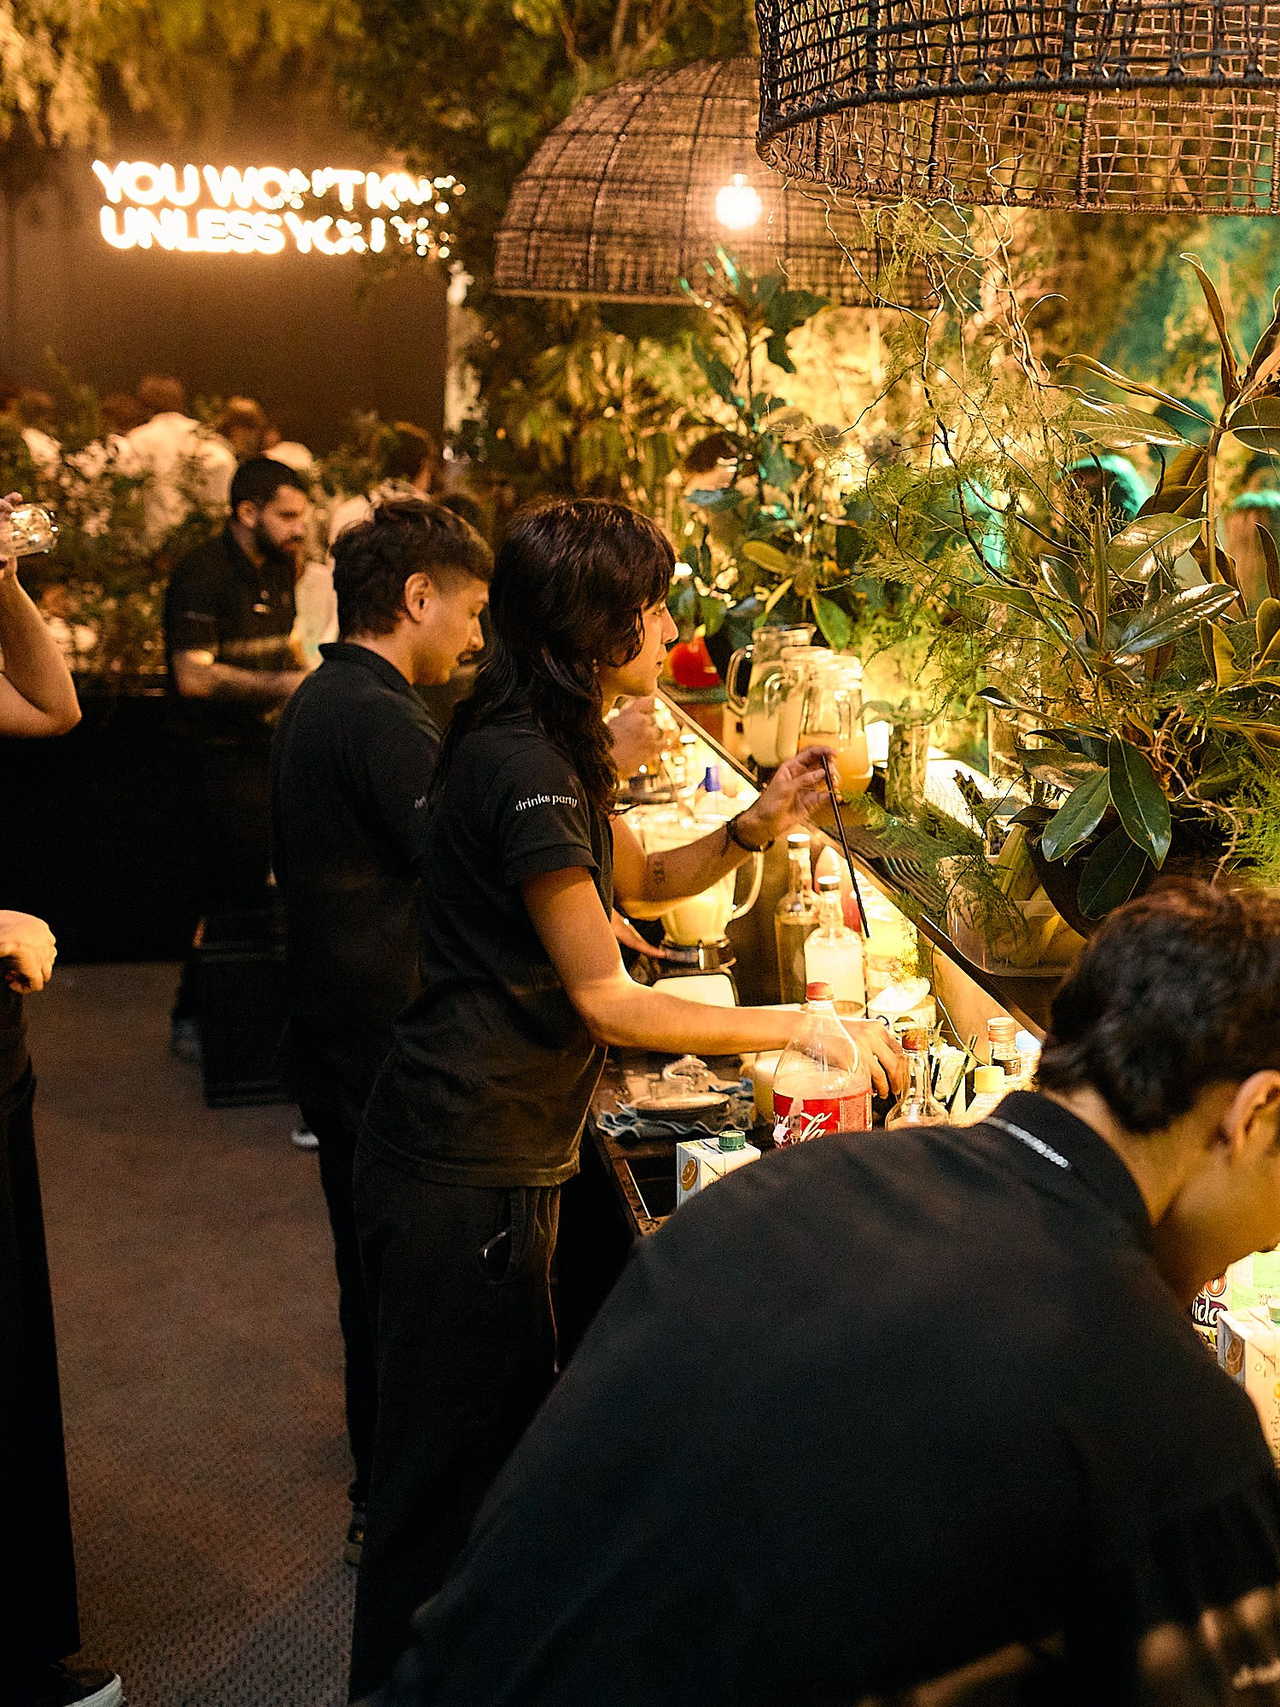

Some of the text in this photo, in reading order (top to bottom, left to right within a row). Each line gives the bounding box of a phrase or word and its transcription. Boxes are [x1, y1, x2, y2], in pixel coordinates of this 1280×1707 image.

[92, 160, 200, 206] YOU
[100, 205, 285, 254] UNLESS
[515, 793, 578, 812] drinks party
